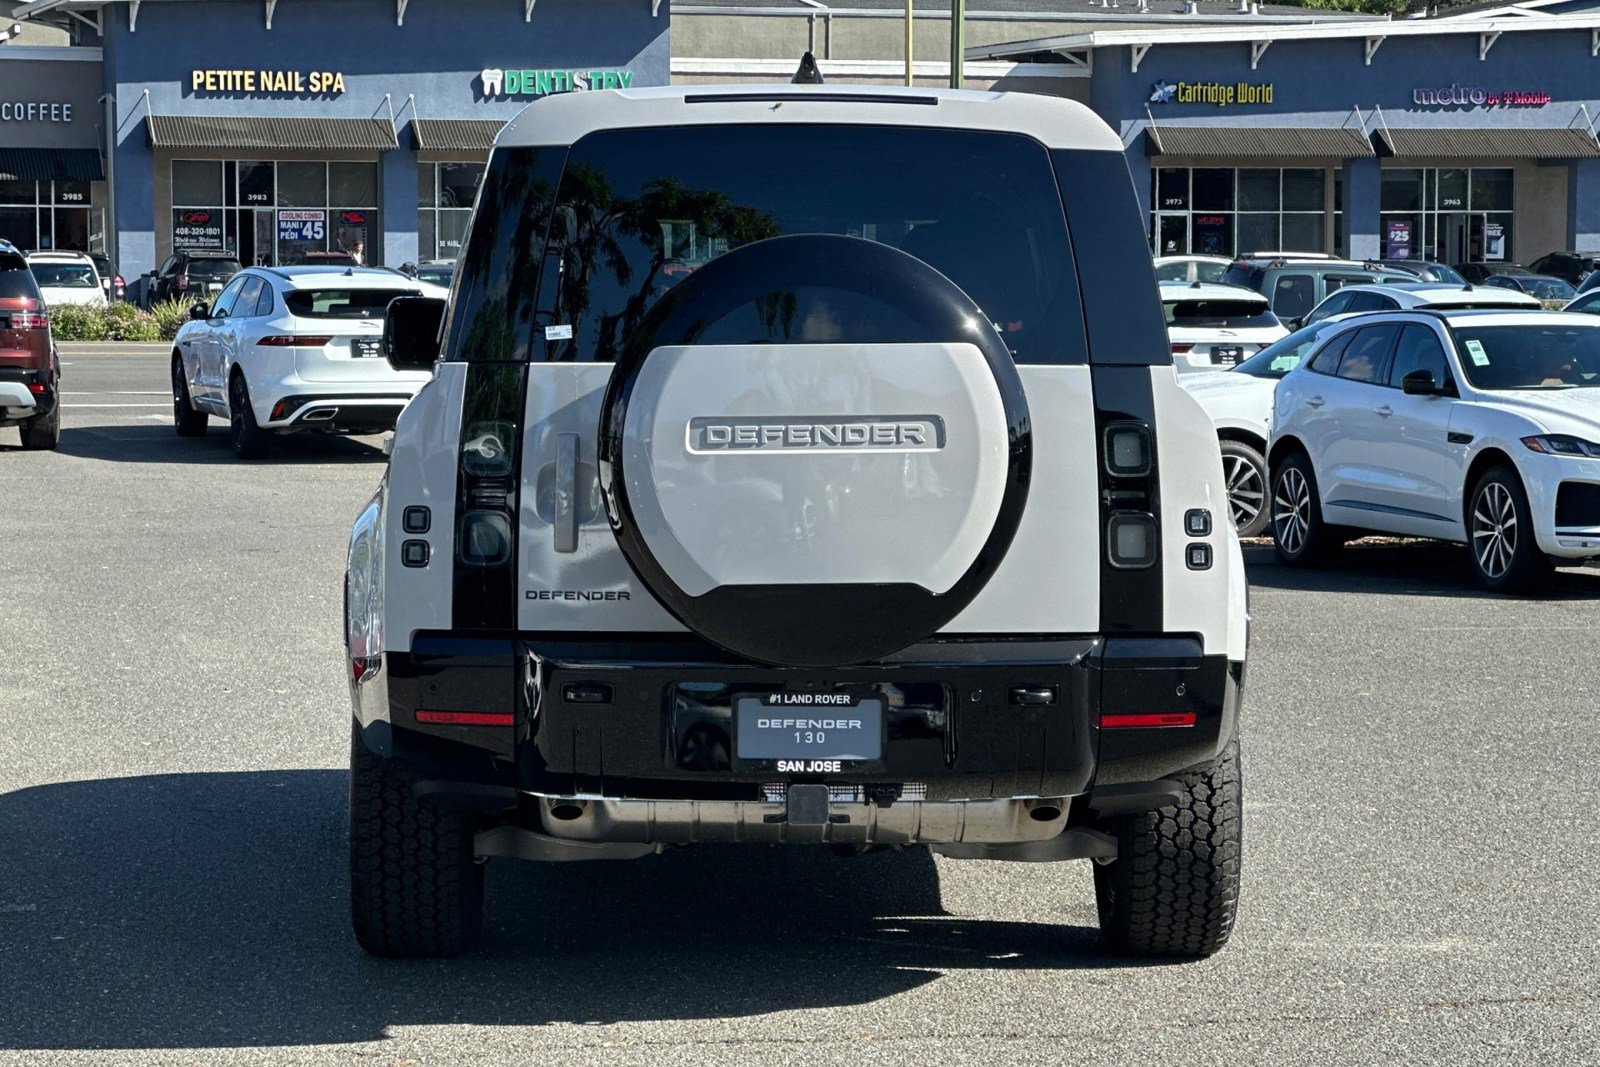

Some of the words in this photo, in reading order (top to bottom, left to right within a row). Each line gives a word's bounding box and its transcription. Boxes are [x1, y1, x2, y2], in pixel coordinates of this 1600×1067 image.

[192, 70, 255, 91] PETITE
[260, 70, 305, 92] NAIL
[308, 71, 346, 93] SPA
[504, 69, 634, 95] DENTISTRY
[1177, 81, 1235, 106] Cartridge
[1237, 82, 1273, 103] World
[1413, 83, 1487, 105] metro
[1, 102, 72, 122] COFFEE
[247, 193, 268, 201] 3983
[280, 221, 299, 229] MANI
[175, 227, 221, 235] 408-320-1801
[280, 231, 299, 239] PEDI
[1390, 230, 1410, 241] $25
[706, 424, 927, 445] DEFENDER
[525, 590, 631, 601] DEFENDER
[769, 694, 782, 704] #1
[784, 694, 813, 704] LAND
[815, 695, 851, 704] ROVER
[757, 719, 862, 729] DEFENDER
[794, 732, 825, 744] 130
[777, 760, 805, 772] SAN
[806, 761, 842, 772] JOSE
